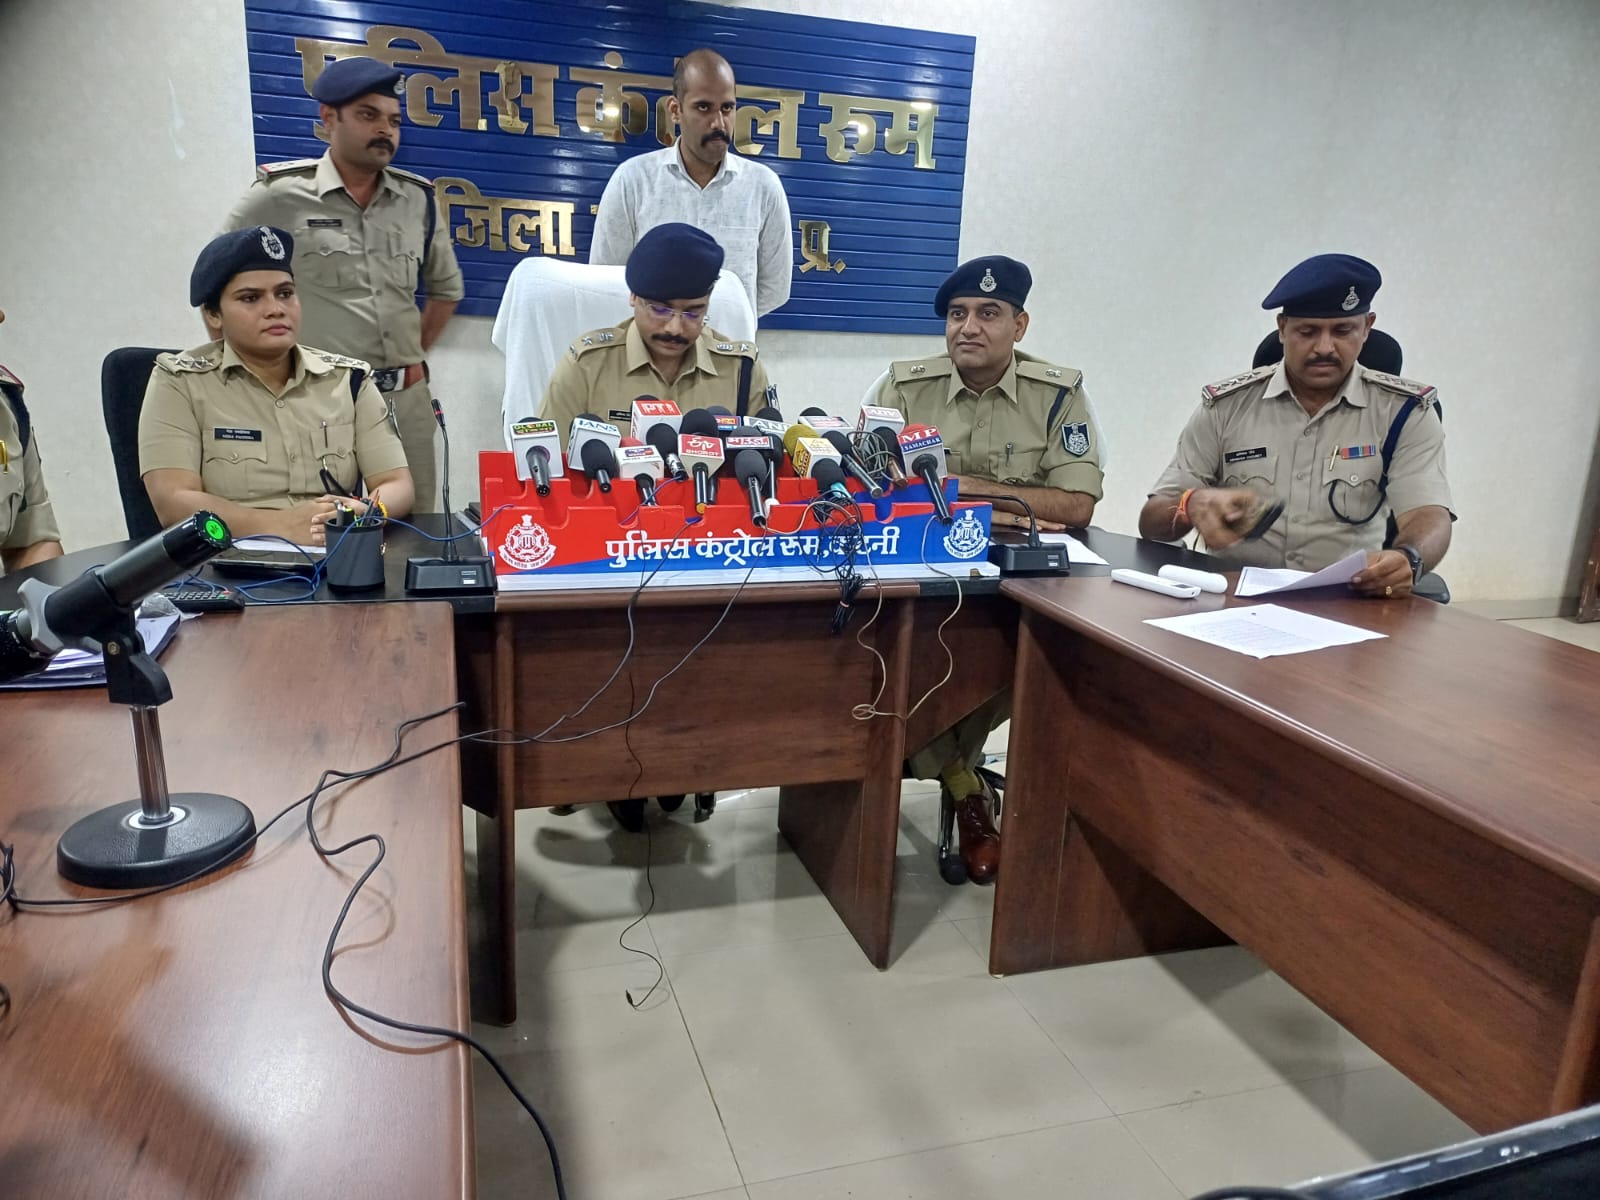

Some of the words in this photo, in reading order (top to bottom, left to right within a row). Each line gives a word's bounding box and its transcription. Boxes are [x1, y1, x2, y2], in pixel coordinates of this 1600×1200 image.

[579, 419, 617, 432] IANS
[904, 437, 941, 450] SAMACHAR
[605, 530, 692, 568] पुलिस
[695, 528, 777, 567] कंट्रोल
